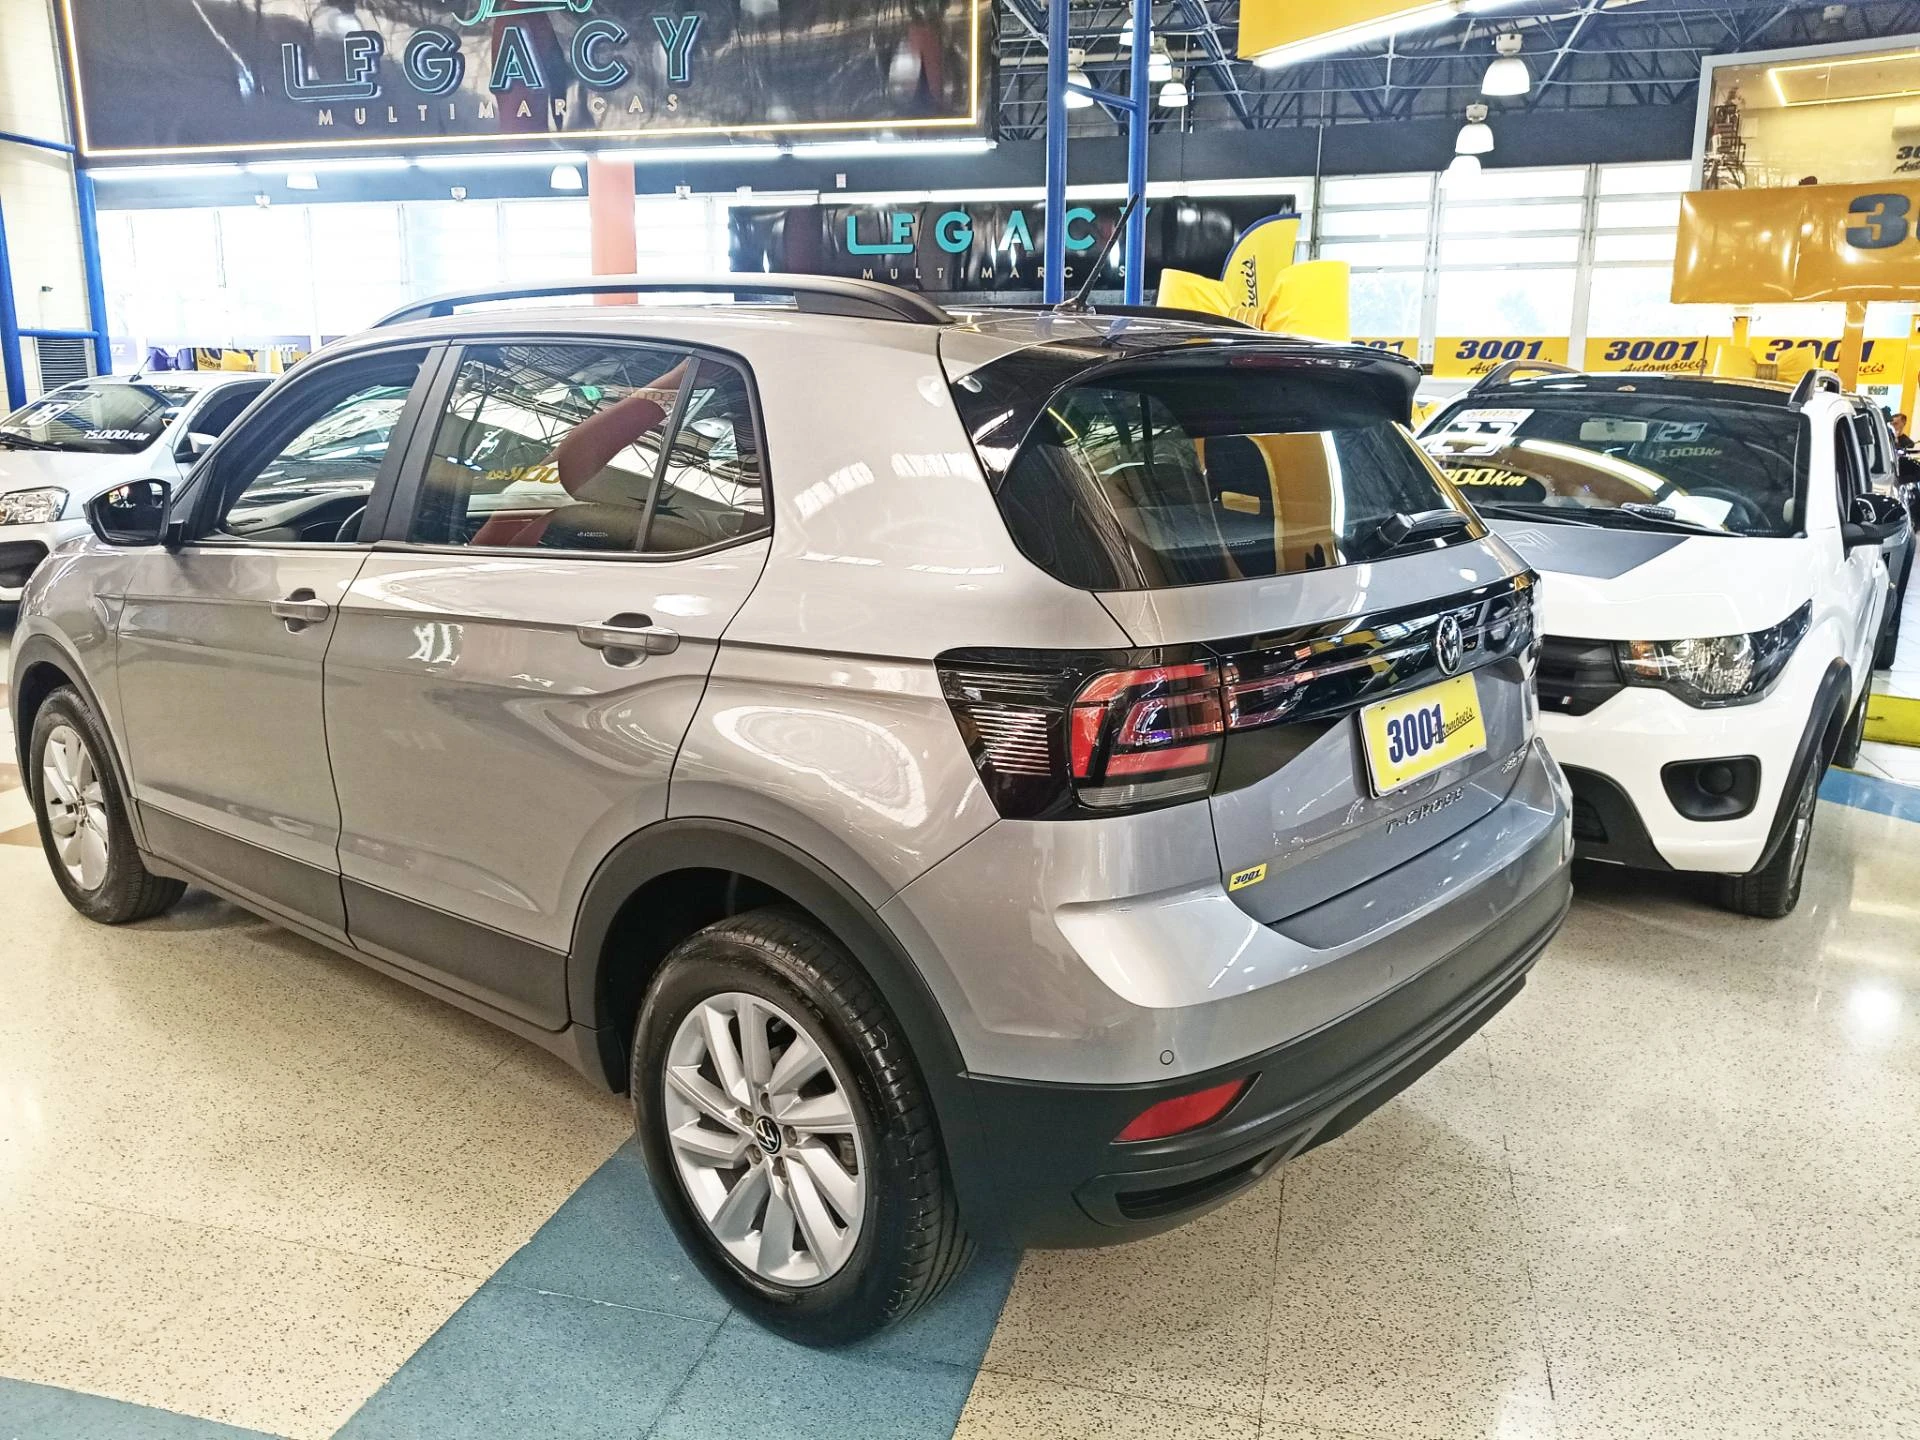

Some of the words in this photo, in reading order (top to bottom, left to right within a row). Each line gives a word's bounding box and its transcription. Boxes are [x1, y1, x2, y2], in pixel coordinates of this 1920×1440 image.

[281, 15, 700, 101] LEGACY
[318, 94, 679, 126] MULTIMARCAS
[862, 265, 1126, 280] MULTIMARCS
[1456, 340, 1543, 360] 3001
[1604, 340, 1698, 361] 3001
[1387, 703, 1444, 763] 3001
[1385, 786, 1466, 835] T-CROSS
